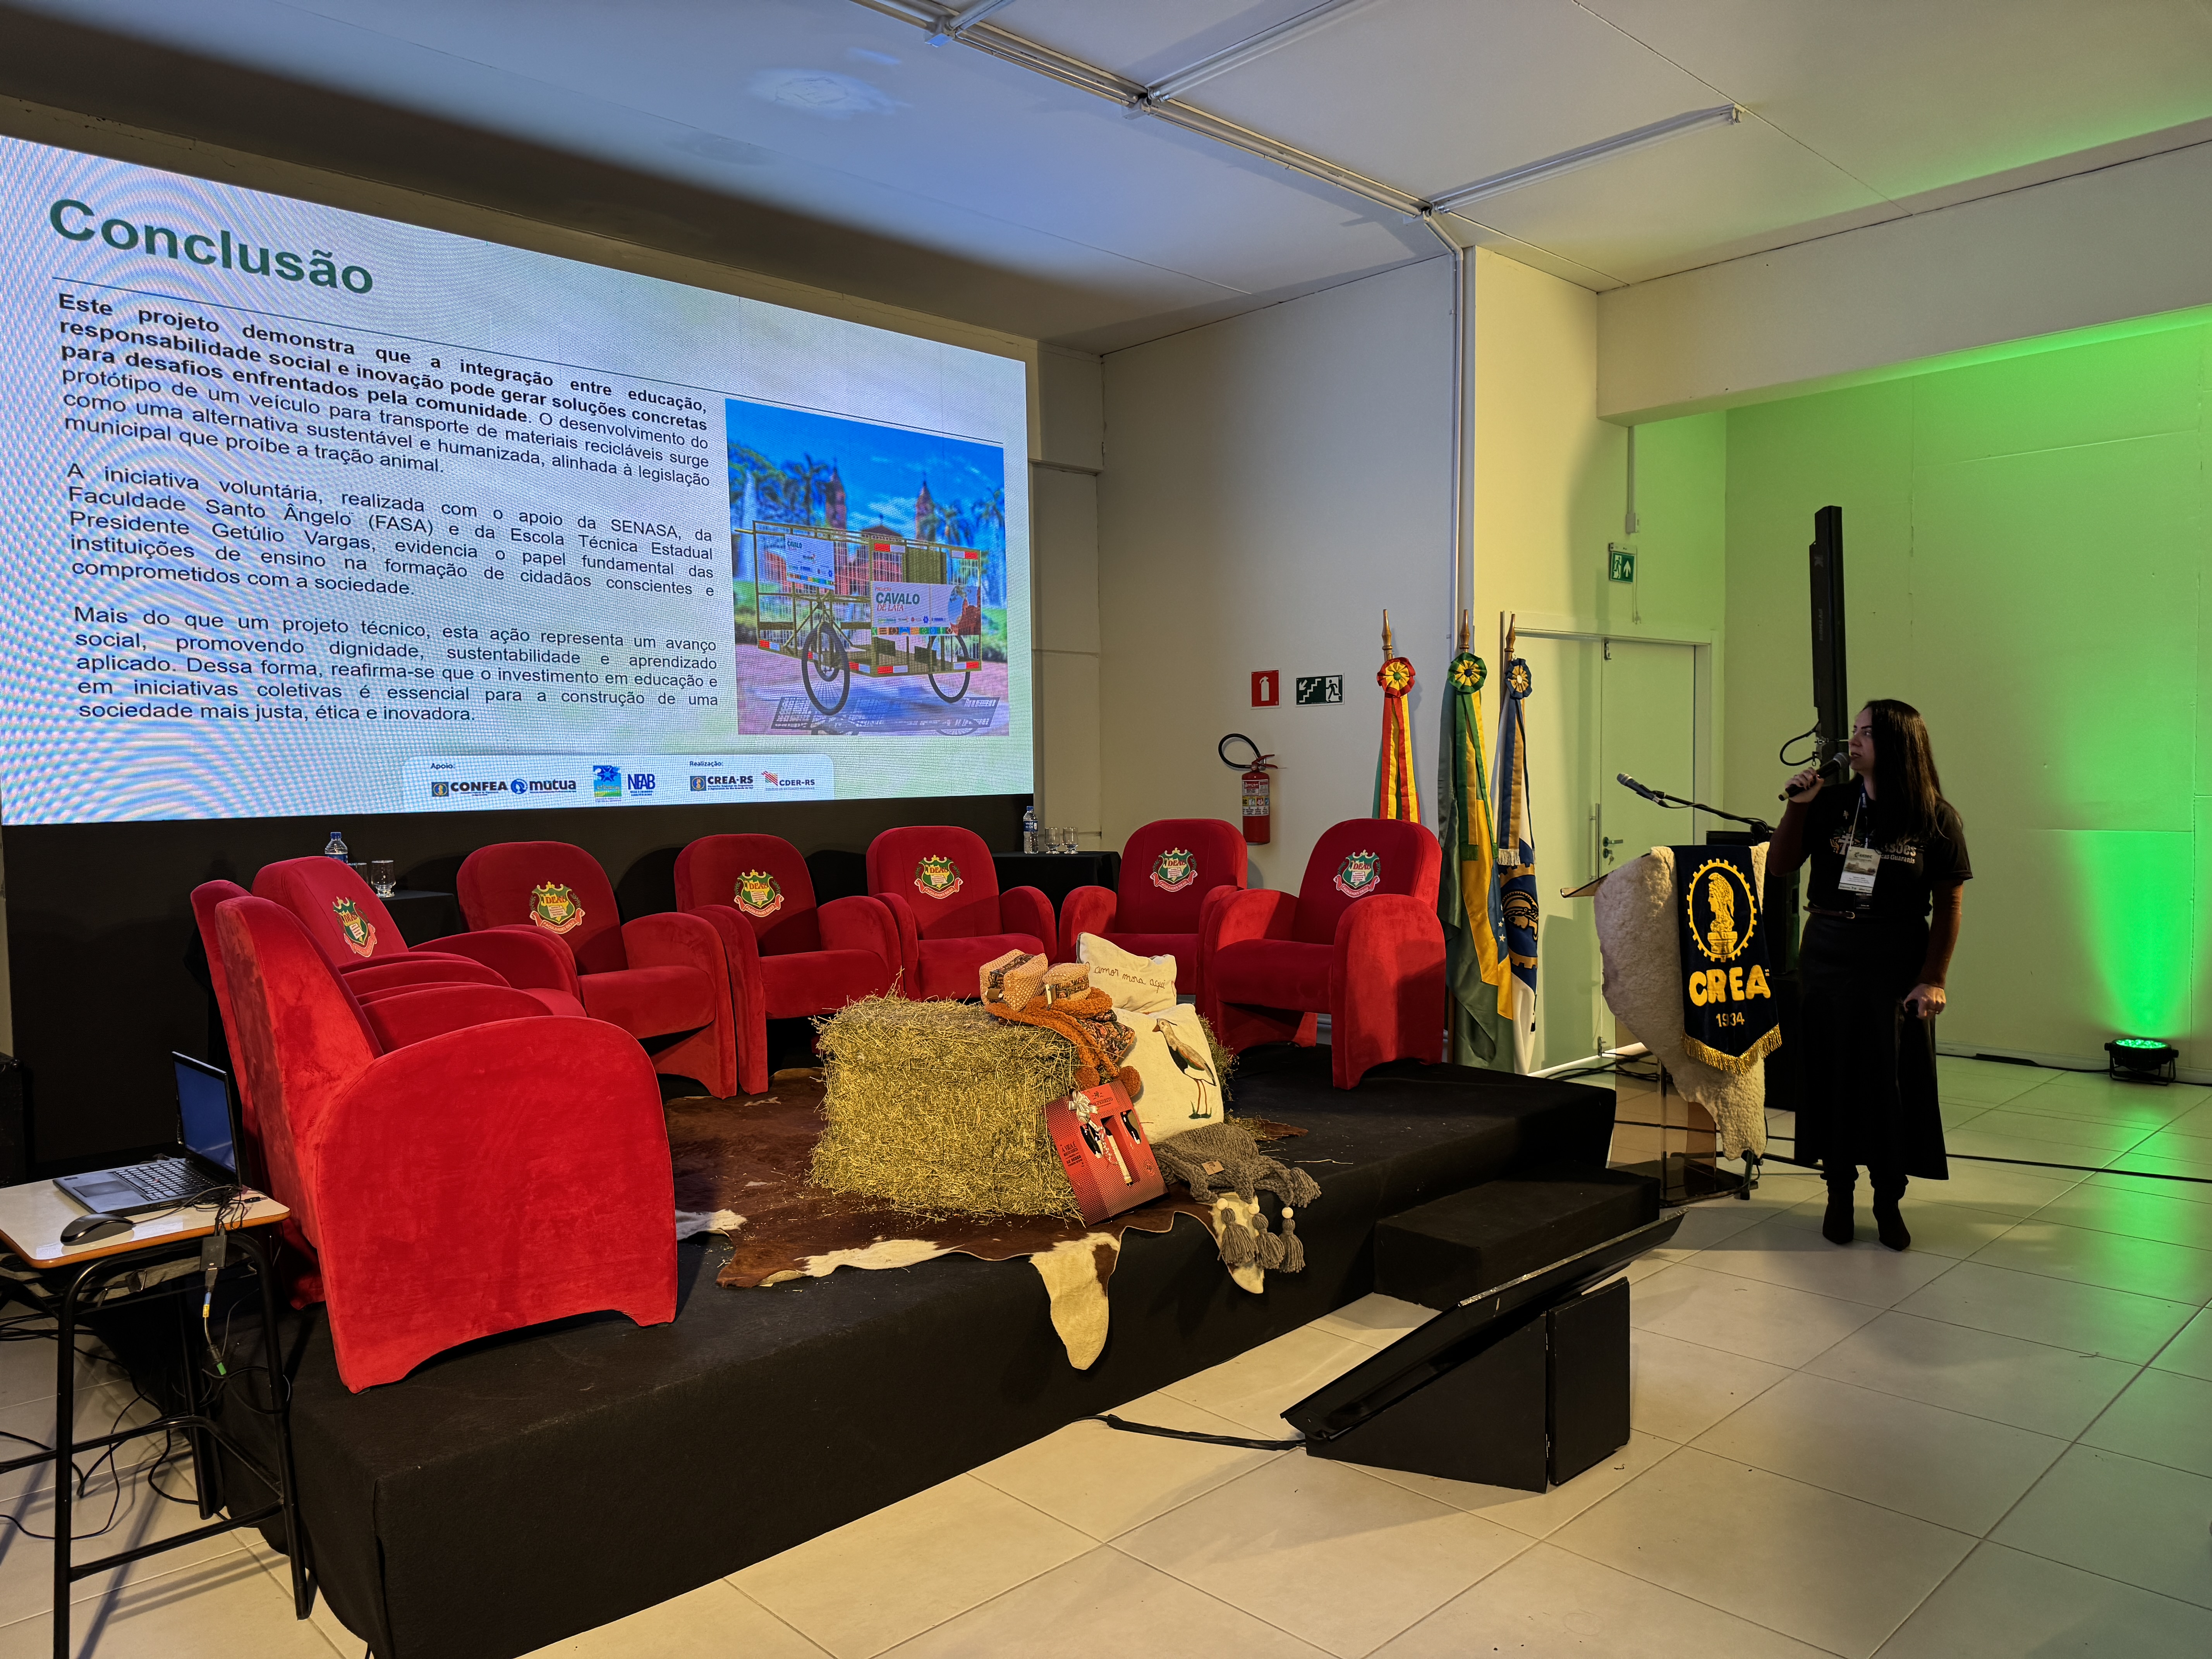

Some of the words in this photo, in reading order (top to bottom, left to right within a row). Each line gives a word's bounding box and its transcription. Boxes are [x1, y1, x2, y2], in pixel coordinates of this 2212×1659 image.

[50, 198, 373, 294] Conclusão
[58, 292, 113, 316] Este
[137, 309, 220, 333] projeto
[241, 323, 355, 355] demonstra
[374, 348, 411, 364] que
[430, 357, 441, 369] a
[460, 362, 553, 386] integração
[569, 380, 612, 396] entre
[627, 389, 706, 413] educação,
[59, 321, 262, 362] responsabilidade
[268, 353, 331, 373] social
[337, 364, 350, 376] e
[356, 366, 444, 390] inovação
[450, 381, 495, 398] pode
[500, 389, 546, 405] gerar
[551, 397, 627, 418] soluções
[631, 410, 707, 431] concretas
[60, 345, 115, 364] para
[124, 352, 223, 379] desafios
[232, 370, 359, 398] enfrentados
[366, 390, 408, 405] pela
[414, 397, 535, 425] comunidade.
[539, 412, 553, 426] O
[558, 416, 685, 445] desenvolvimento
[690, 436, 708, 449] do
[62, 369, 161, 393] protótipo
[171, 382, 198, 398] de
[208, 389, 240, 403] um
[249, 395, 320, 414] veículo
[329, 405, 371, 421] para
[379, 410, 469, 434] transporte
[476, 424, 497, 438] de
[505, 429, 578, 449] materiais
[584, 441, 663, 461] recicláveis
[669, 453, 709, 469] surge
[62, 393, 127, 412] como
[135, 403, 183, 419] uma
[192, 409, 299, 434] alternativa
[306, 425, 412, 448] sustentável
[419, 439, 431, 450] e
[437, 438, 547, 469] humanizada,
[552, 455, 617, 474] alinhada
[623, 465, 632, 476] à
[638, 465, 709, 487] legislação
[64, 417, 171, 440] municipal
[178, 431, 218, 446] que
[225, 436, 290, 454] proíbe
[296, 445, 309, 457] a
[314, 444, 374, 465] tração
[379, 455, 447, 474] animal.
[67, 462, 84, 478] A
[104, 470, 199, 489] iniciativa
[219, 481, 326, 507] voluntária,
[341, 493, 424, 512] realizada
[440, 503, 477, 516] com
[493, 509, 503, 520] o
[518, 512, 563, 526] apoio
[577, 516, 596, 529] da
[611, 519, 684, 541] SENASA,
[695, 529, 712, 541] da
[67, 485, 185, 511] Faculdade
[205, 498, 266, 518] Santo
[283, 503, 352, 527] Ângelo
[368, 514, 433, 534] (FASA)
[448, 525, 459, 535] e
[474, 525, 495, 539] da
[510, 527, 565, 545] Escola
[578, 534, 638, 552] Técnica
[651, 542, 712, 559] Estadual
[69, 510, 190, 534] Presidente
[211, 522, 285, 543] Getúlio
[303, 530, 379, 554] Vargas,
[394, 541, 477, 558] evidencia
[495, 550, 505, 560] o
[522, 552, 565, 566] papel
[581, 555, 673, 574] fundamental
[688, 565, 713, 578] das
[70, 538, 195, 559] instituições
[215, 546, 240, 561] de
[260, 552, 326, 567] ensino
[344, 558, 367, 570] na
[384, 558, 467, 579] formação
[483, 567, 504, 580] de
[520, 571, 591, 586] cidadãos
[606, 579, 692, 594] conscientes
[71, 562, 240, 584] comprometidos
[246, 574, 289, 587] com
[295, 577, 308, 588] a
[314, 578, 418, 595] sociedade.
[876, 592, 920, 605] CAVALO
[73, 606, 129, 623] Mais
[143, 610, 170, 625] do
[184, 614, 224, 629] que
[237, 618, 269, 629] um
[282, 619, 349, 635] projeto
[360, 621, 433, 641] técnico,
[441, 626, 478, 639] esta
[489, 628, 530, 644] ação
[540, 632, 623, 646] representa
[634, 638, 656, 647] um
[666, 639, 717, 653] avanço
[75, 633, 150, 652] social,
[175, 637, 304, 653] promovendo
[329, 641, 427, 662] dignidade,
[447, 647, 580, 663] sustentabilidade
[600, 655, 609, 665] e
[629, 657, 716, 669] aprendizado
[75, 655, 181, 673] aplicado.
[185, 657, 252, 674] Dessa
[260, 659, 326, 680] forma,
[330, 663, 434, 678] reafirma-se
[442, 668, 474, 681] que
[480, 670, 491, 680] o
[498, 670, 599, 683] investimento
[605, 674, 628, 684] em
[634, 674, 703, 688] educação
[76, 681, 112, 693] em
[133, 681, 238, 696] iniciativas
[256, 683, 342, 697] coletivas
[359, 687, 371, 698] é
[386, 687, 469, 700] essencial
[484, 690, 522, 703] para
[537, 692, 546, 701] a
[561, 691, 644, 707] construção
[657, 694, 675, 704] de
[689, 696, 718, 705] uma
[78, 703, 193, 717] sociedade
[199, 706, 250, 718] mais
[255, 705, 311, 722] justa,
[314, 706, 360, 719] ética
[366, 709, 377, 720] e
[383, 707, 478, 720] inovadora.
[450, 781, 508, 792] CONFEA
[1094, 966, 1119, 977] amor
[1122, 973, 1146, 985] mora
[1149, 980, 1166, 994] aqui
[1689, 964, 1771, 1006] CREA
[1716, 1012, 1745, 1027] 1934
